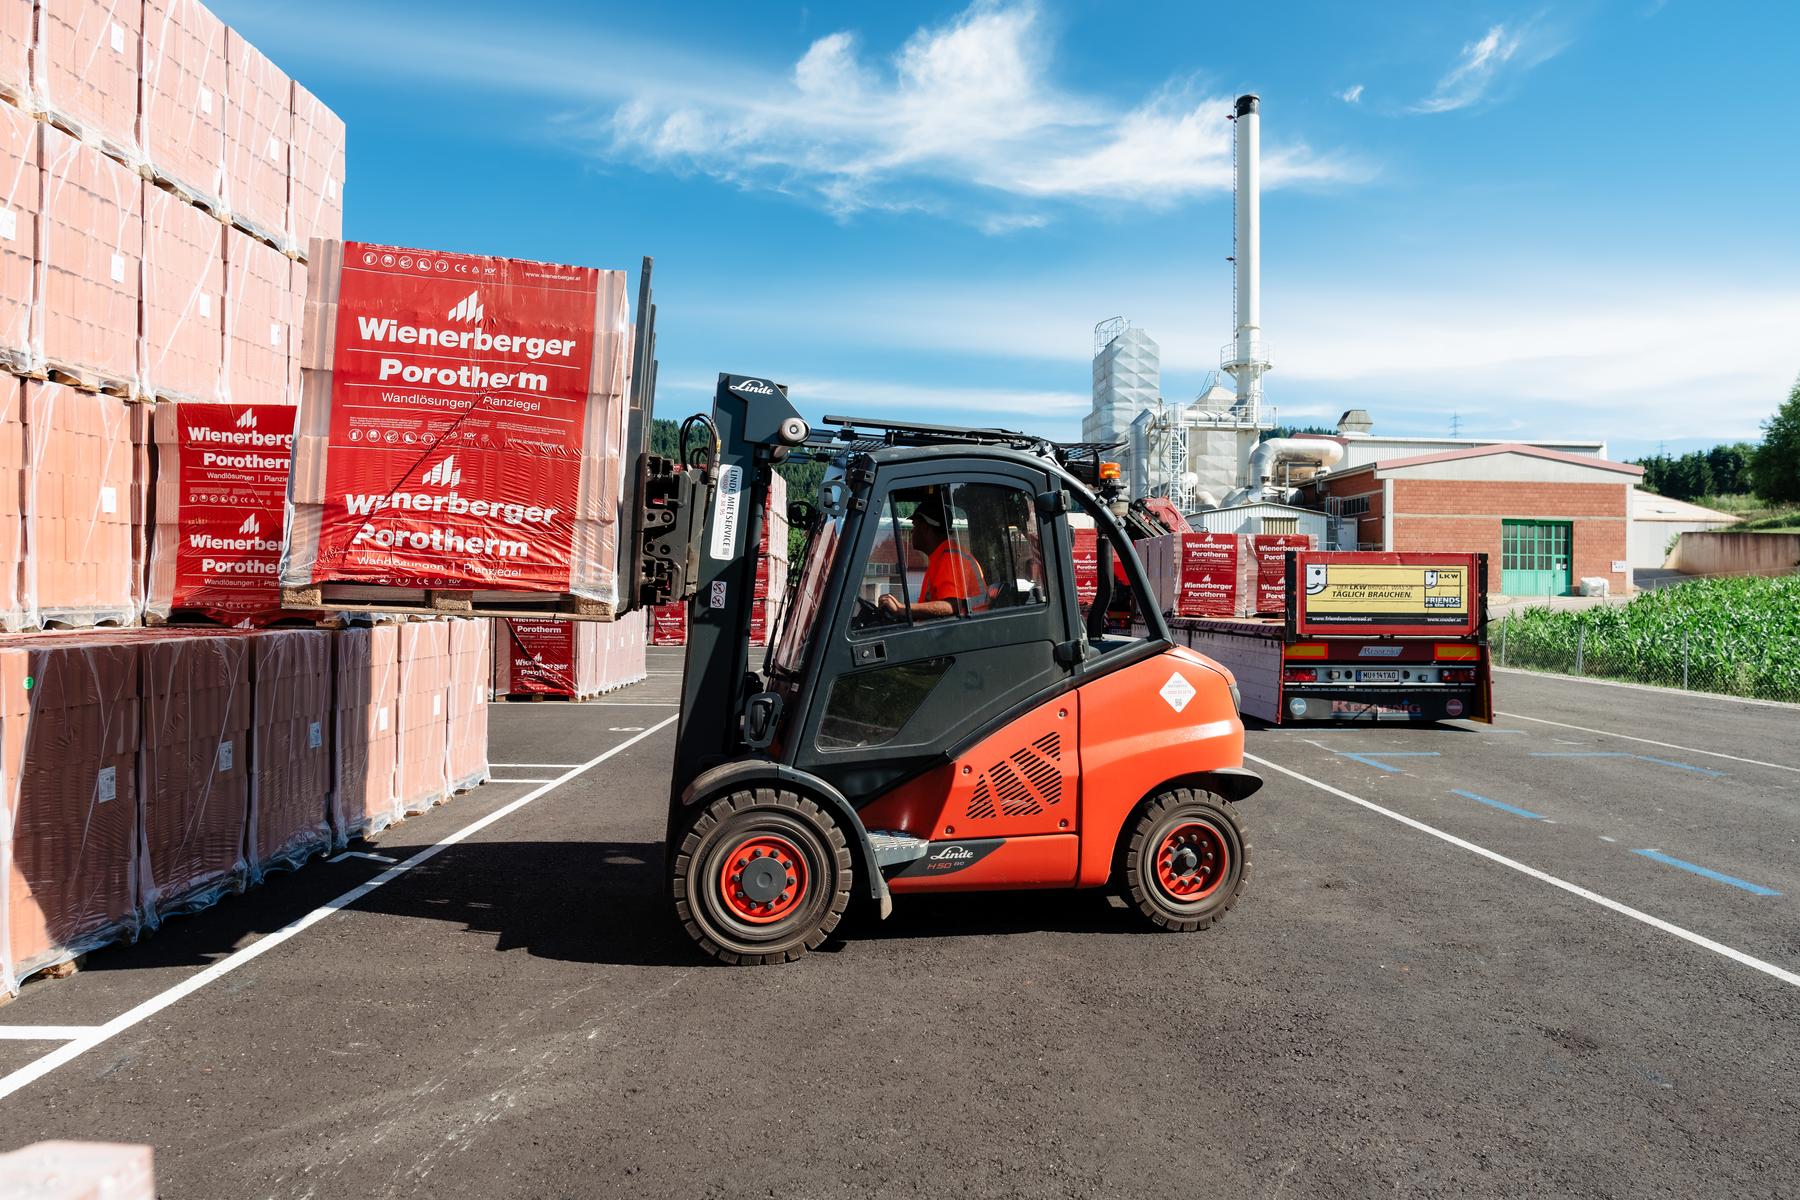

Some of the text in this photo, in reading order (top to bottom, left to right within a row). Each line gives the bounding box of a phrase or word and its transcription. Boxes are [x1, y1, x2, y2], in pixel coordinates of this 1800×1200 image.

[358, 317, 576, 359] Wienerberger
[379, 358, 548, 391] Porotherm
[730, 380, 773, 395] Linde
[382, 392, 472, 409] Wandlösungen
[721, 470, 738, 547] LINDE MIETSERVICE
[352, 523, 529, 558] Porotherm
[1184, 582, 1232, 590] Wienerberger
[1332, 590, 1365, 598] TÄGLICH
[930, 845, 974, 859] Linde
